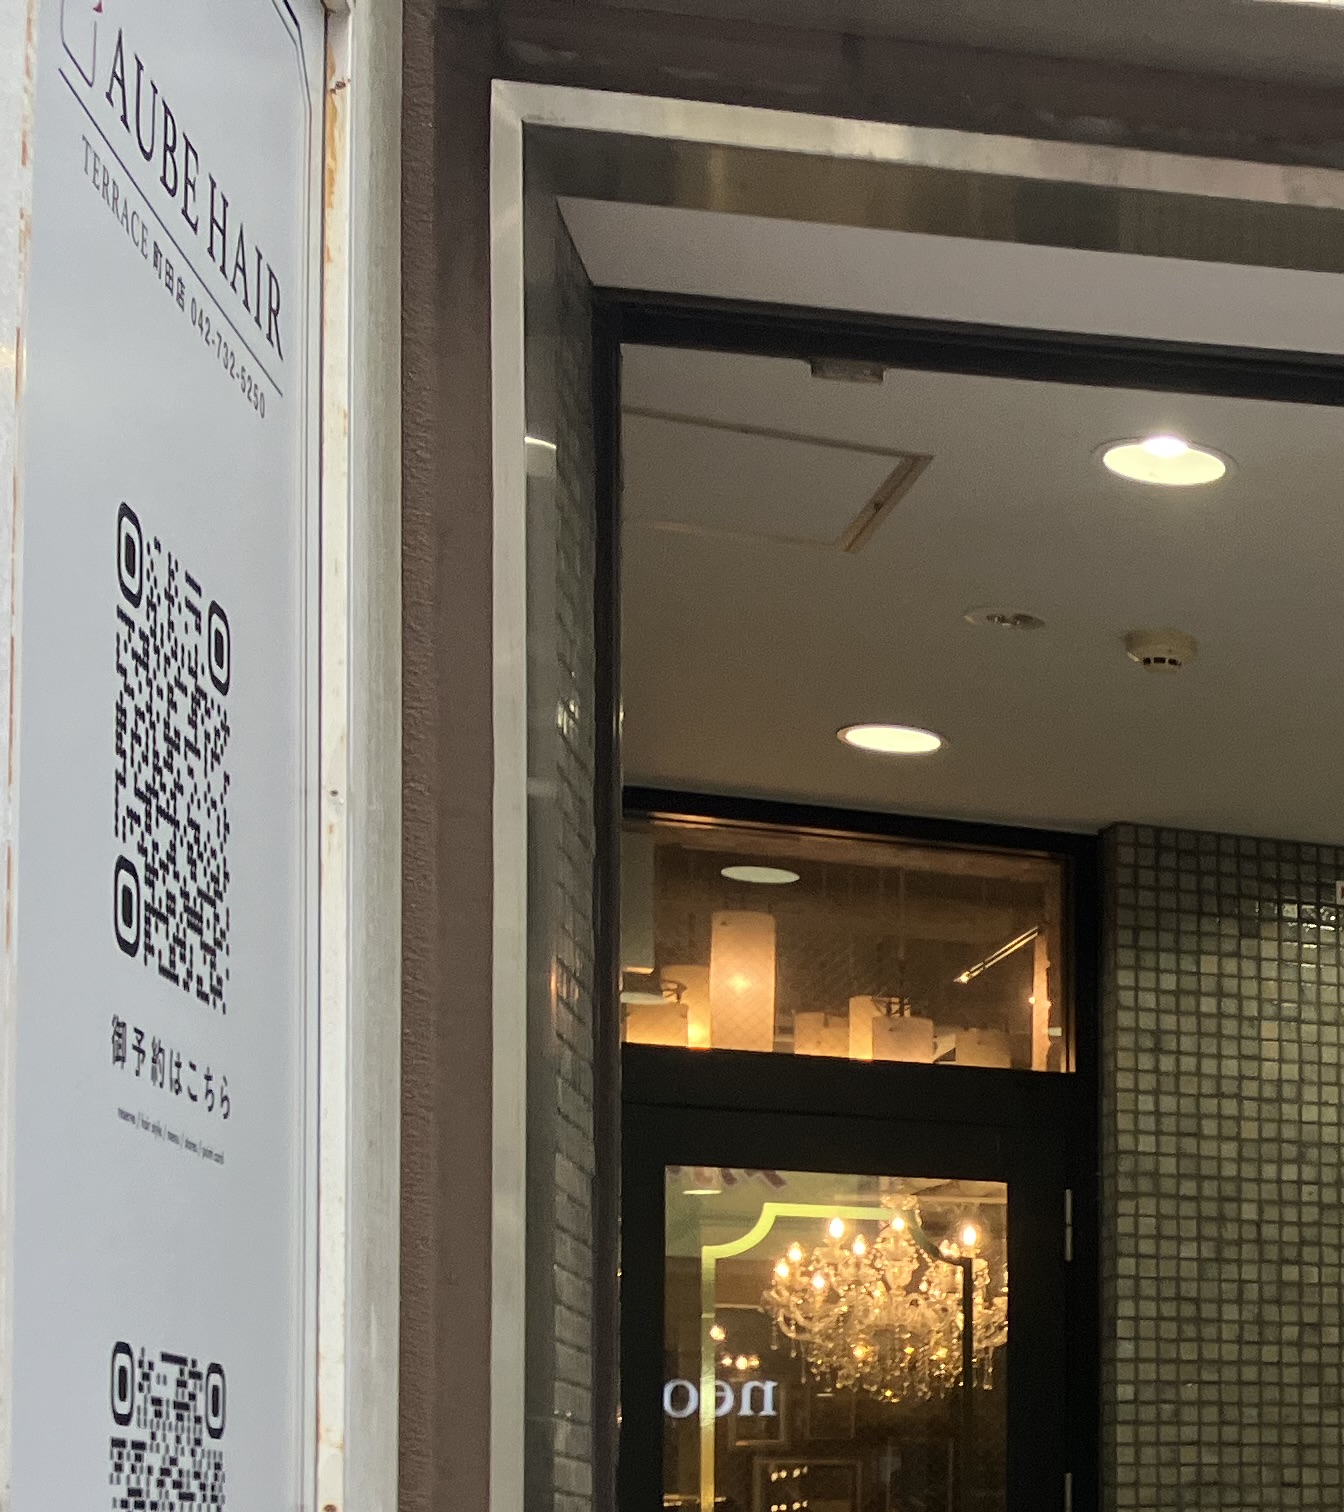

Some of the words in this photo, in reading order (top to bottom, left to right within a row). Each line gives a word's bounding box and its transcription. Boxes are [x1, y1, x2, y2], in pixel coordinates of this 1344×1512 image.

[82, 135, 149, 260] TERRACE
[153, 240, 186, 312] 町田店
[190, 297, 266, 419] 042-732-5250
[105, 27, 199, 235] AUBE
[207, 173, 283, 361] HAIR
[111, 1014, 231, 1120] 御予約はこちら
